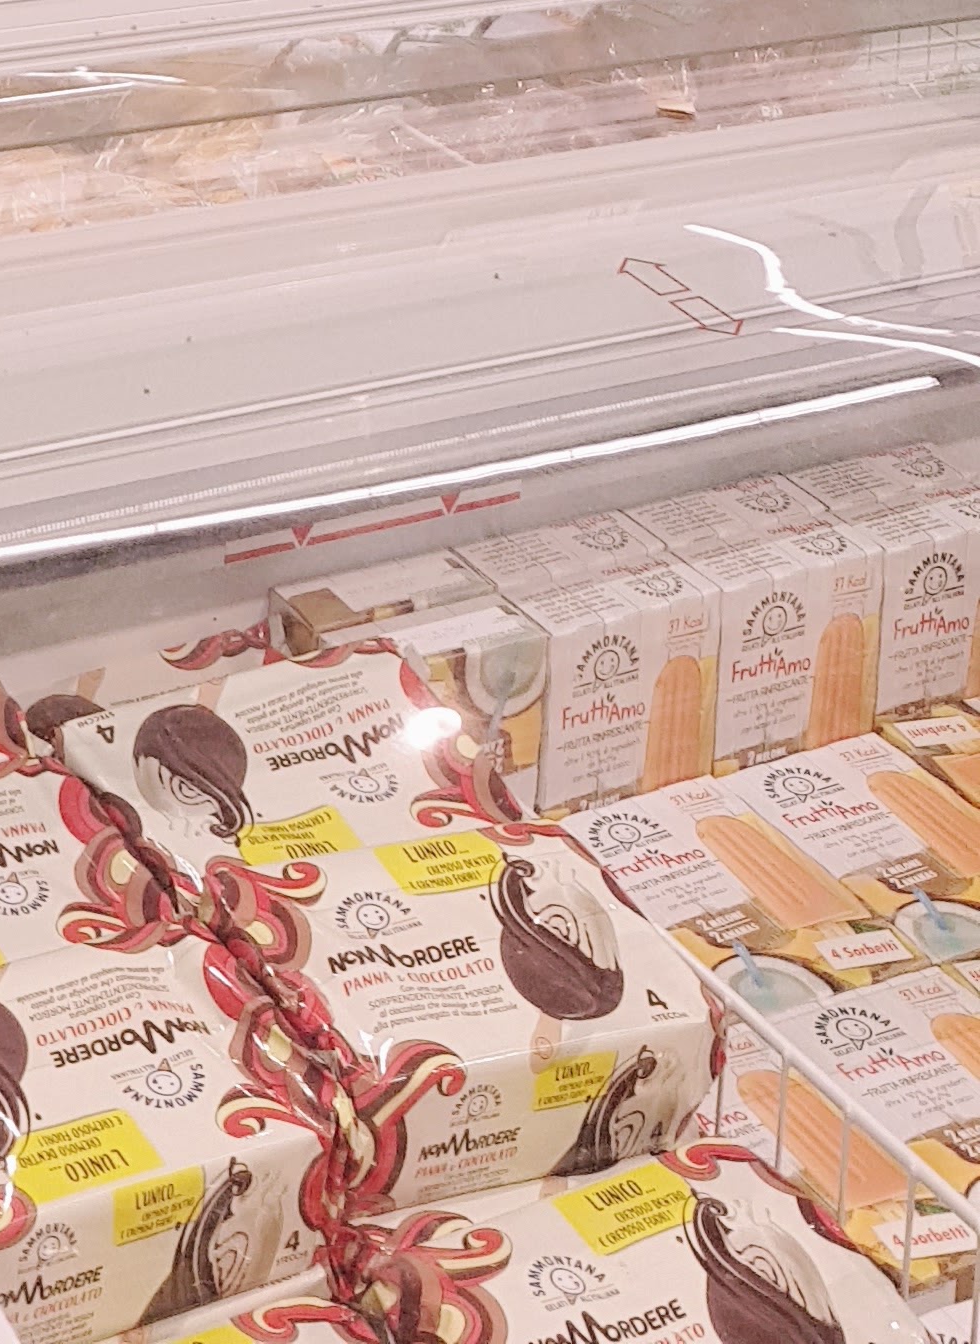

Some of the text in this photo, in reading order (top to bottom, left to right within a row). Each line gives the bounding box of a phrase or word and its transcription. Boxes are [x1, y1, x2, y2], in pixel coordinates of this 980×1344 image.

[904, 552, 965, 595] SAMMONTANA
[743, 591, 806, 635] SAMMONTANA
[894, 611, 970, 640] FruttiAmo
[573, 635, 640, 681] AMMONTANA
[732, 654, 811, 683] FruttiAmo
[347, 698, 391, 724] PANNA
[562, 697, 645, 730] FruttiAmo
[94, 723, 114, 743] 4
[253, 722, 334, 754] CIOCCOLATO
[329, 773, 399, 804] SAMMONTANA
[764, 767, 832, 799] SAMMONTANA
[1, 822, 46, 838] PANNA
[588, 813, 661, 848] SAMMONTANA
[782, 801, 879, 828] FruttiAmo
[604, 849, 705, 879] FruttiAmo
[335, 891, 411, 929] SAMMONTANA
[831, 939, 898, 959] 4 Sorbetti
[343, 958, 494, 996] PANNA CIOCCOLATO
[647, 988, 668, 1010] 4
[36, 1000, 194, 1046] PANNA CIOCCOLATO
[814, 1006, 892, 1045] SAMMONTANA
[836, 1050, 946, 1082] FruttiAmo
[122, 1062, 205, 1108] SAMMONTANA
[18, 1223, 76, 1262] SAMMONTANA
[286, 1231, 300, 1251] 4
[528, 1255, 606, 1297] SAMMONTANA
